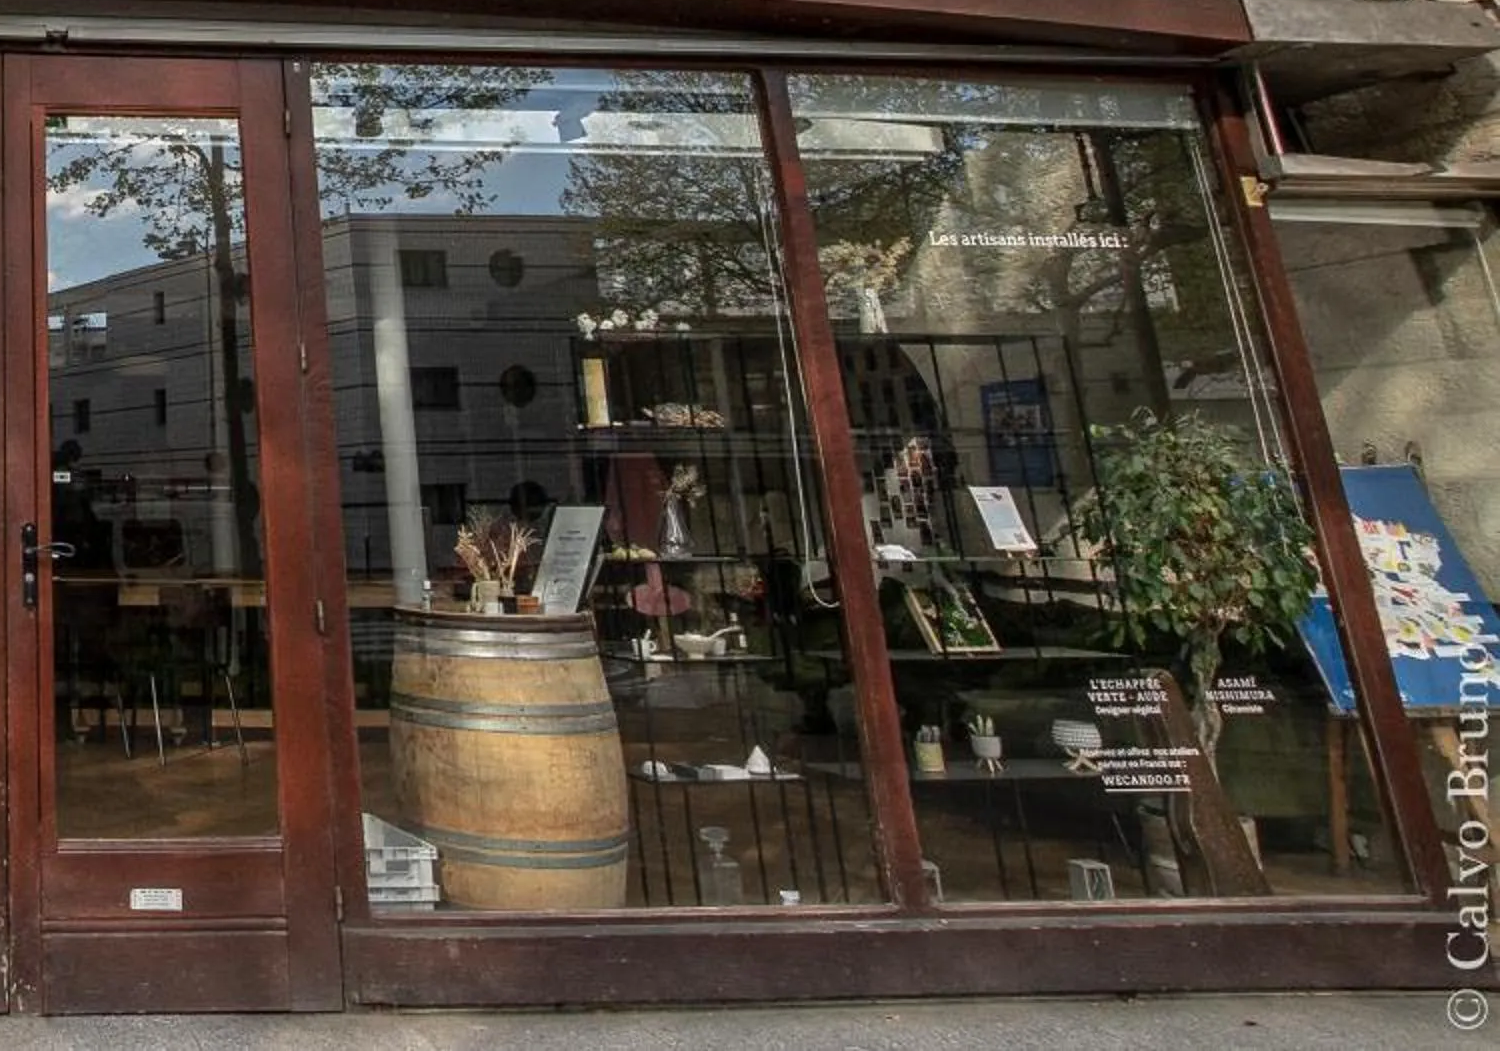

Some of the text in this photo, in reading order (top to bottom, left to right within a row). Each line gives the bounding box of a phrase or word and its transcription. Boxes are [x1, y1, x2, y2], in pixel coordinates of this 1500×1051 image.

[929, 231, 957, 246] Les
[961, 232, 1025, 246] artisans
[1029, 232, 1096, 248] installés
[1087, 692, 1127, 702] VERTE
[1137, 692, 1169, 702] AUDE
[1102, 774, 1190, 786] WECANDOO.FR
